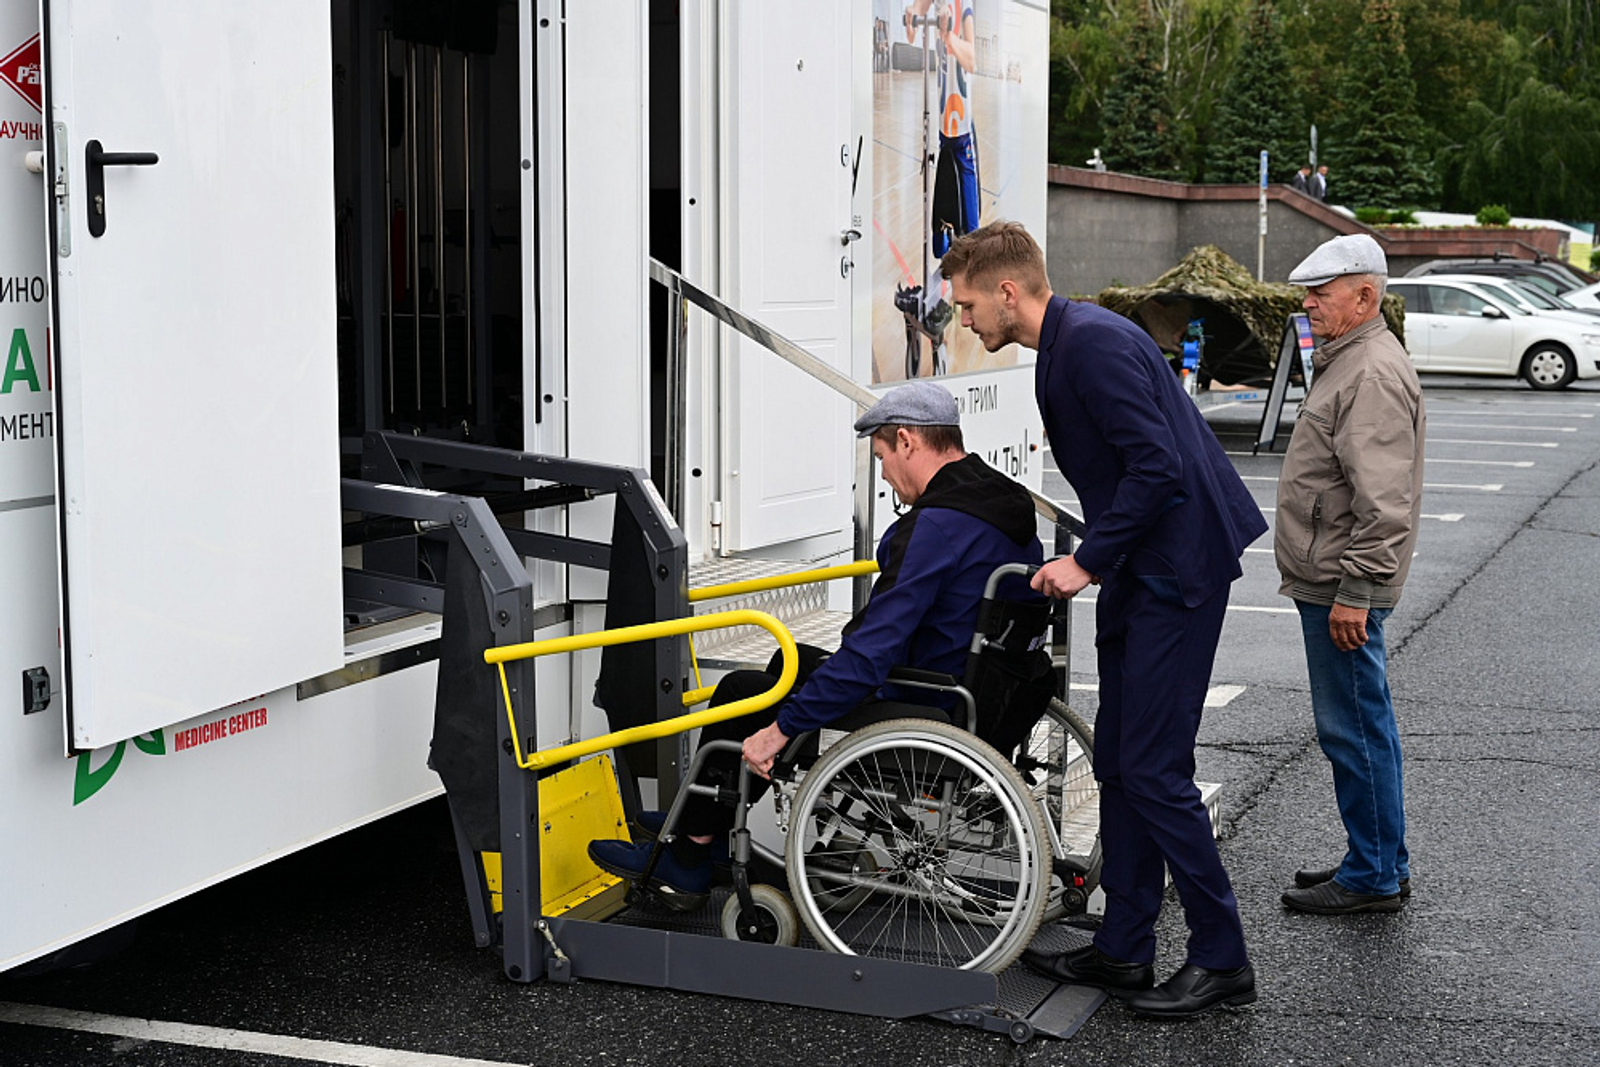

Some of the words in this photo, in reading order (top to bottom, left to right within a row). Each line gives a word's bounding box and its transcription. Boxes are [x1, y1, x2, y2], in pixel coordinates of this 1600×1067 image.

[0, 120, 43, 141] АУЧН
[0, 276, 49, 303] ИНО
[968, 384, 998, 414] ТРИМ
[174, 719, 227, 752] MEDICINE
[229, 707, 267, 735] CENTER
